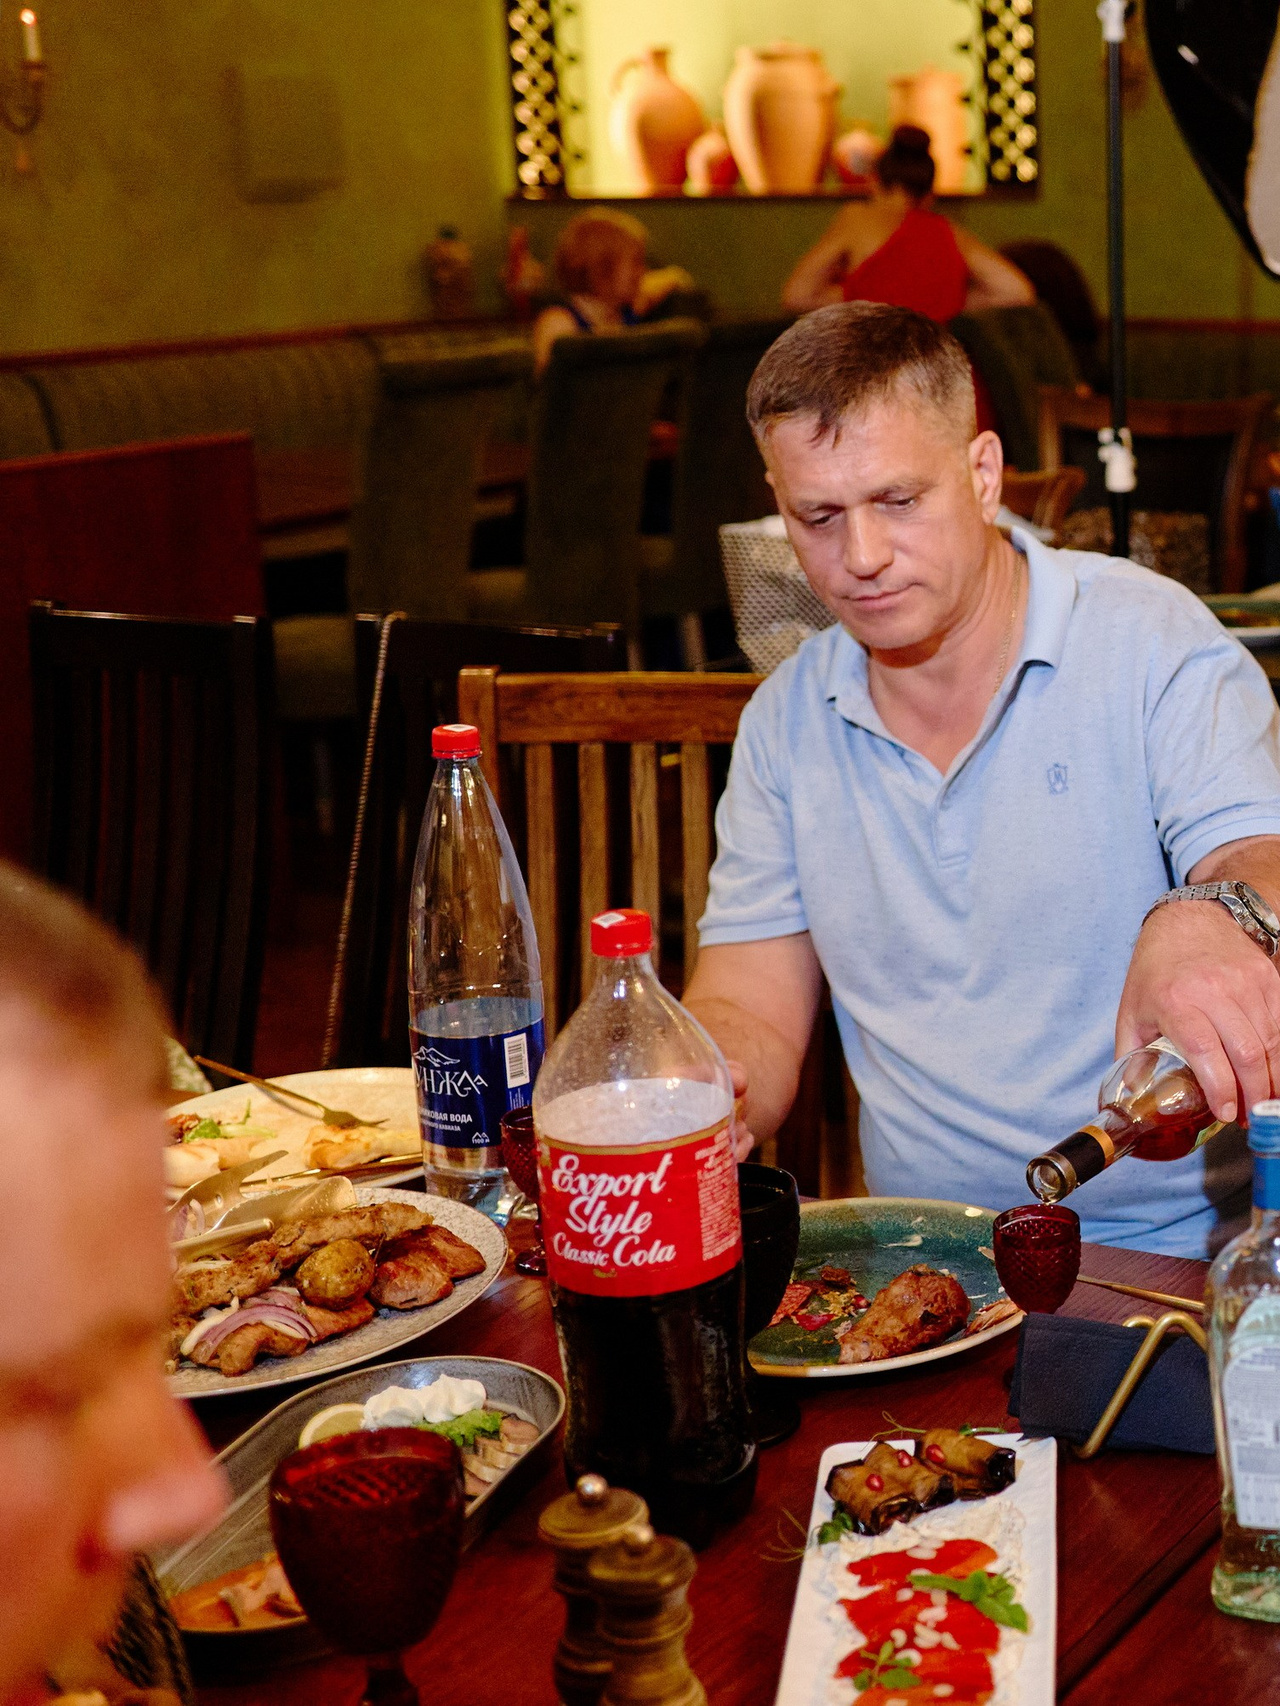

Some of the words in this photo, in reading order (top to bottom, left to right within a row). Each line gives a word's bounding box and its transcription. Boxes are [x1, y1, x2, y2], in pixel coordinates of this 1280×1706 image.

[449, 1113, 473, 1124] ВОДА
[551, 1152, 673, 1216] Export
[565, 1195, 653, 1247] Style
[553, 1232, 610, 1266] Classic
[612, 1234, 677, 1267] Cola
